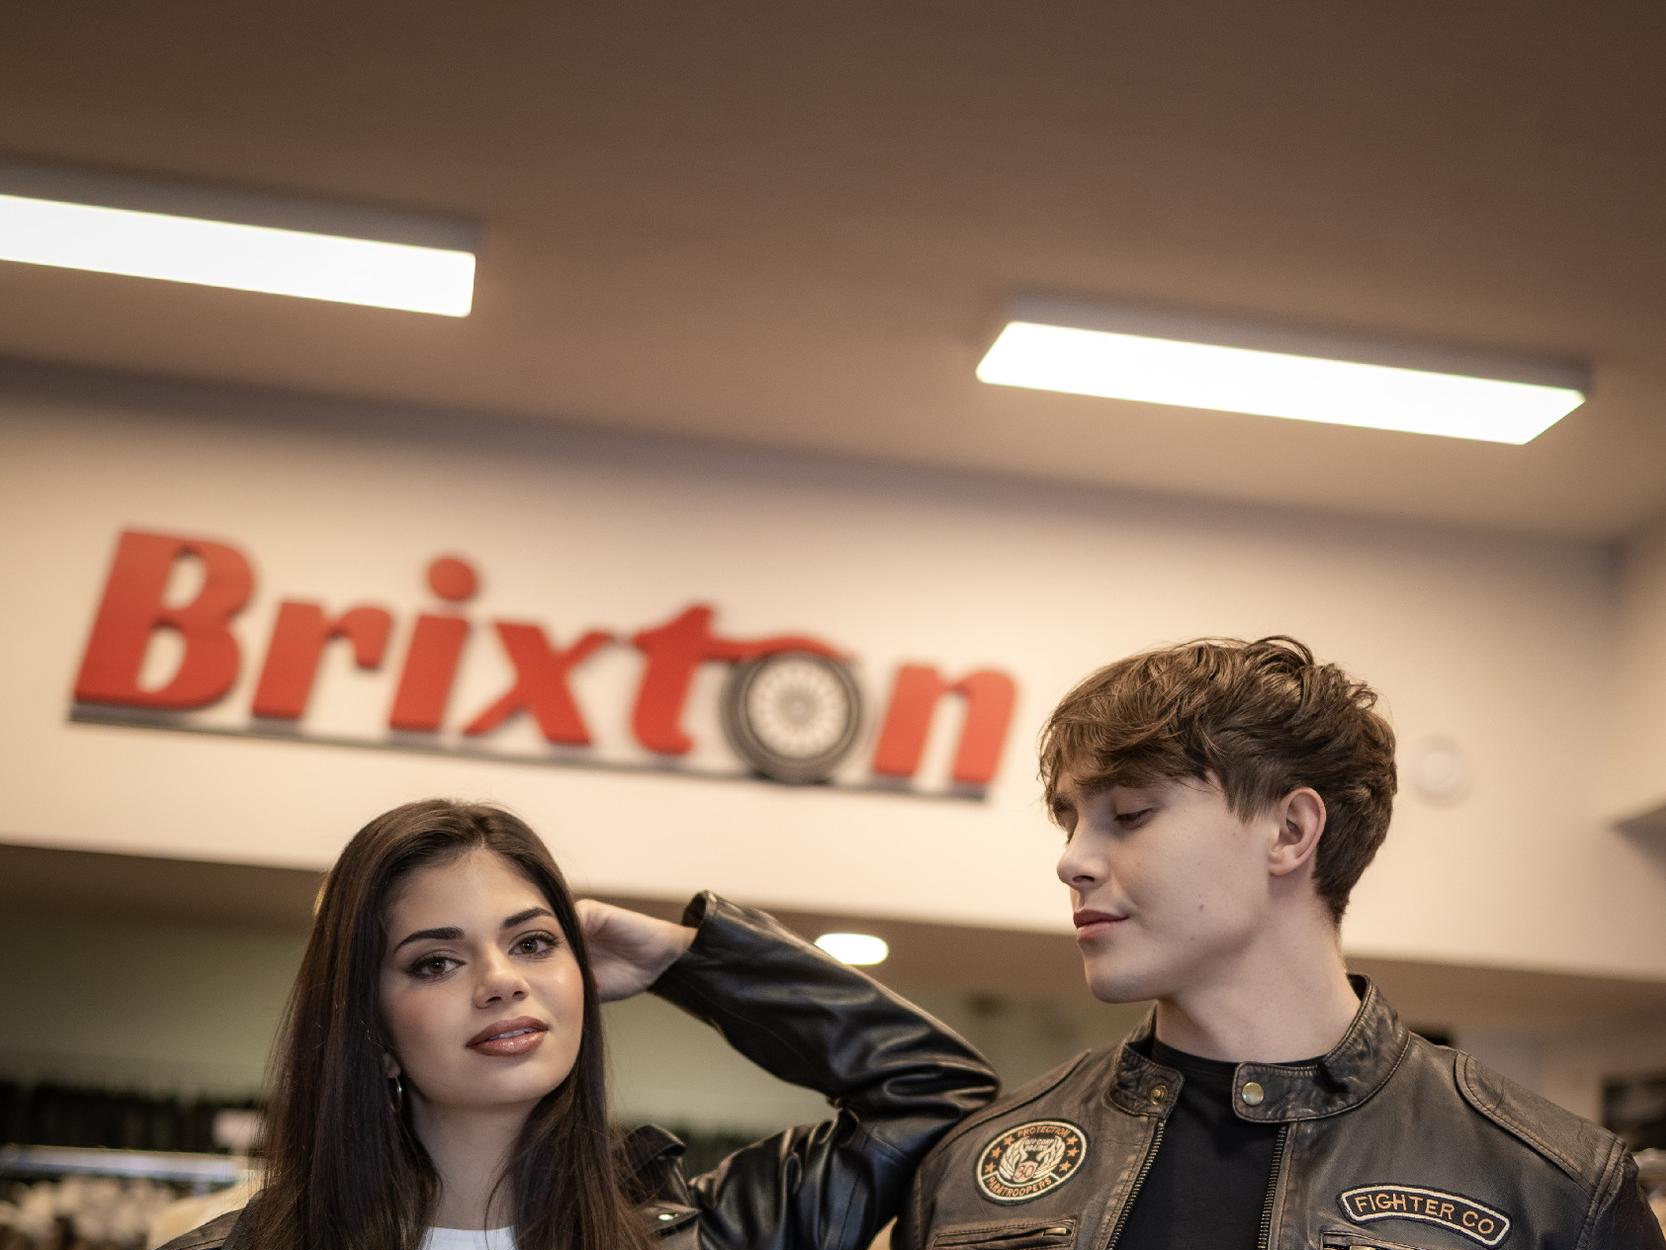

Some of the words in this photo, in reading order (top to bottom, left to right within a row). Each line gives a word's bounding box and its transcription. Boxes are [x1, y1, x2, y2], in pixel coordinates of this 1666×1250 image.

[73, 527, 1022, 784] Brixton
[1017, 1125, 1071, 1137] PROTECTION
[988, 1176, 1052, 1197] PARATROOPERS
[1354, 1193, 1455, 1220] FIGHTER
[1462, 1210, 1495, 1234] CO
